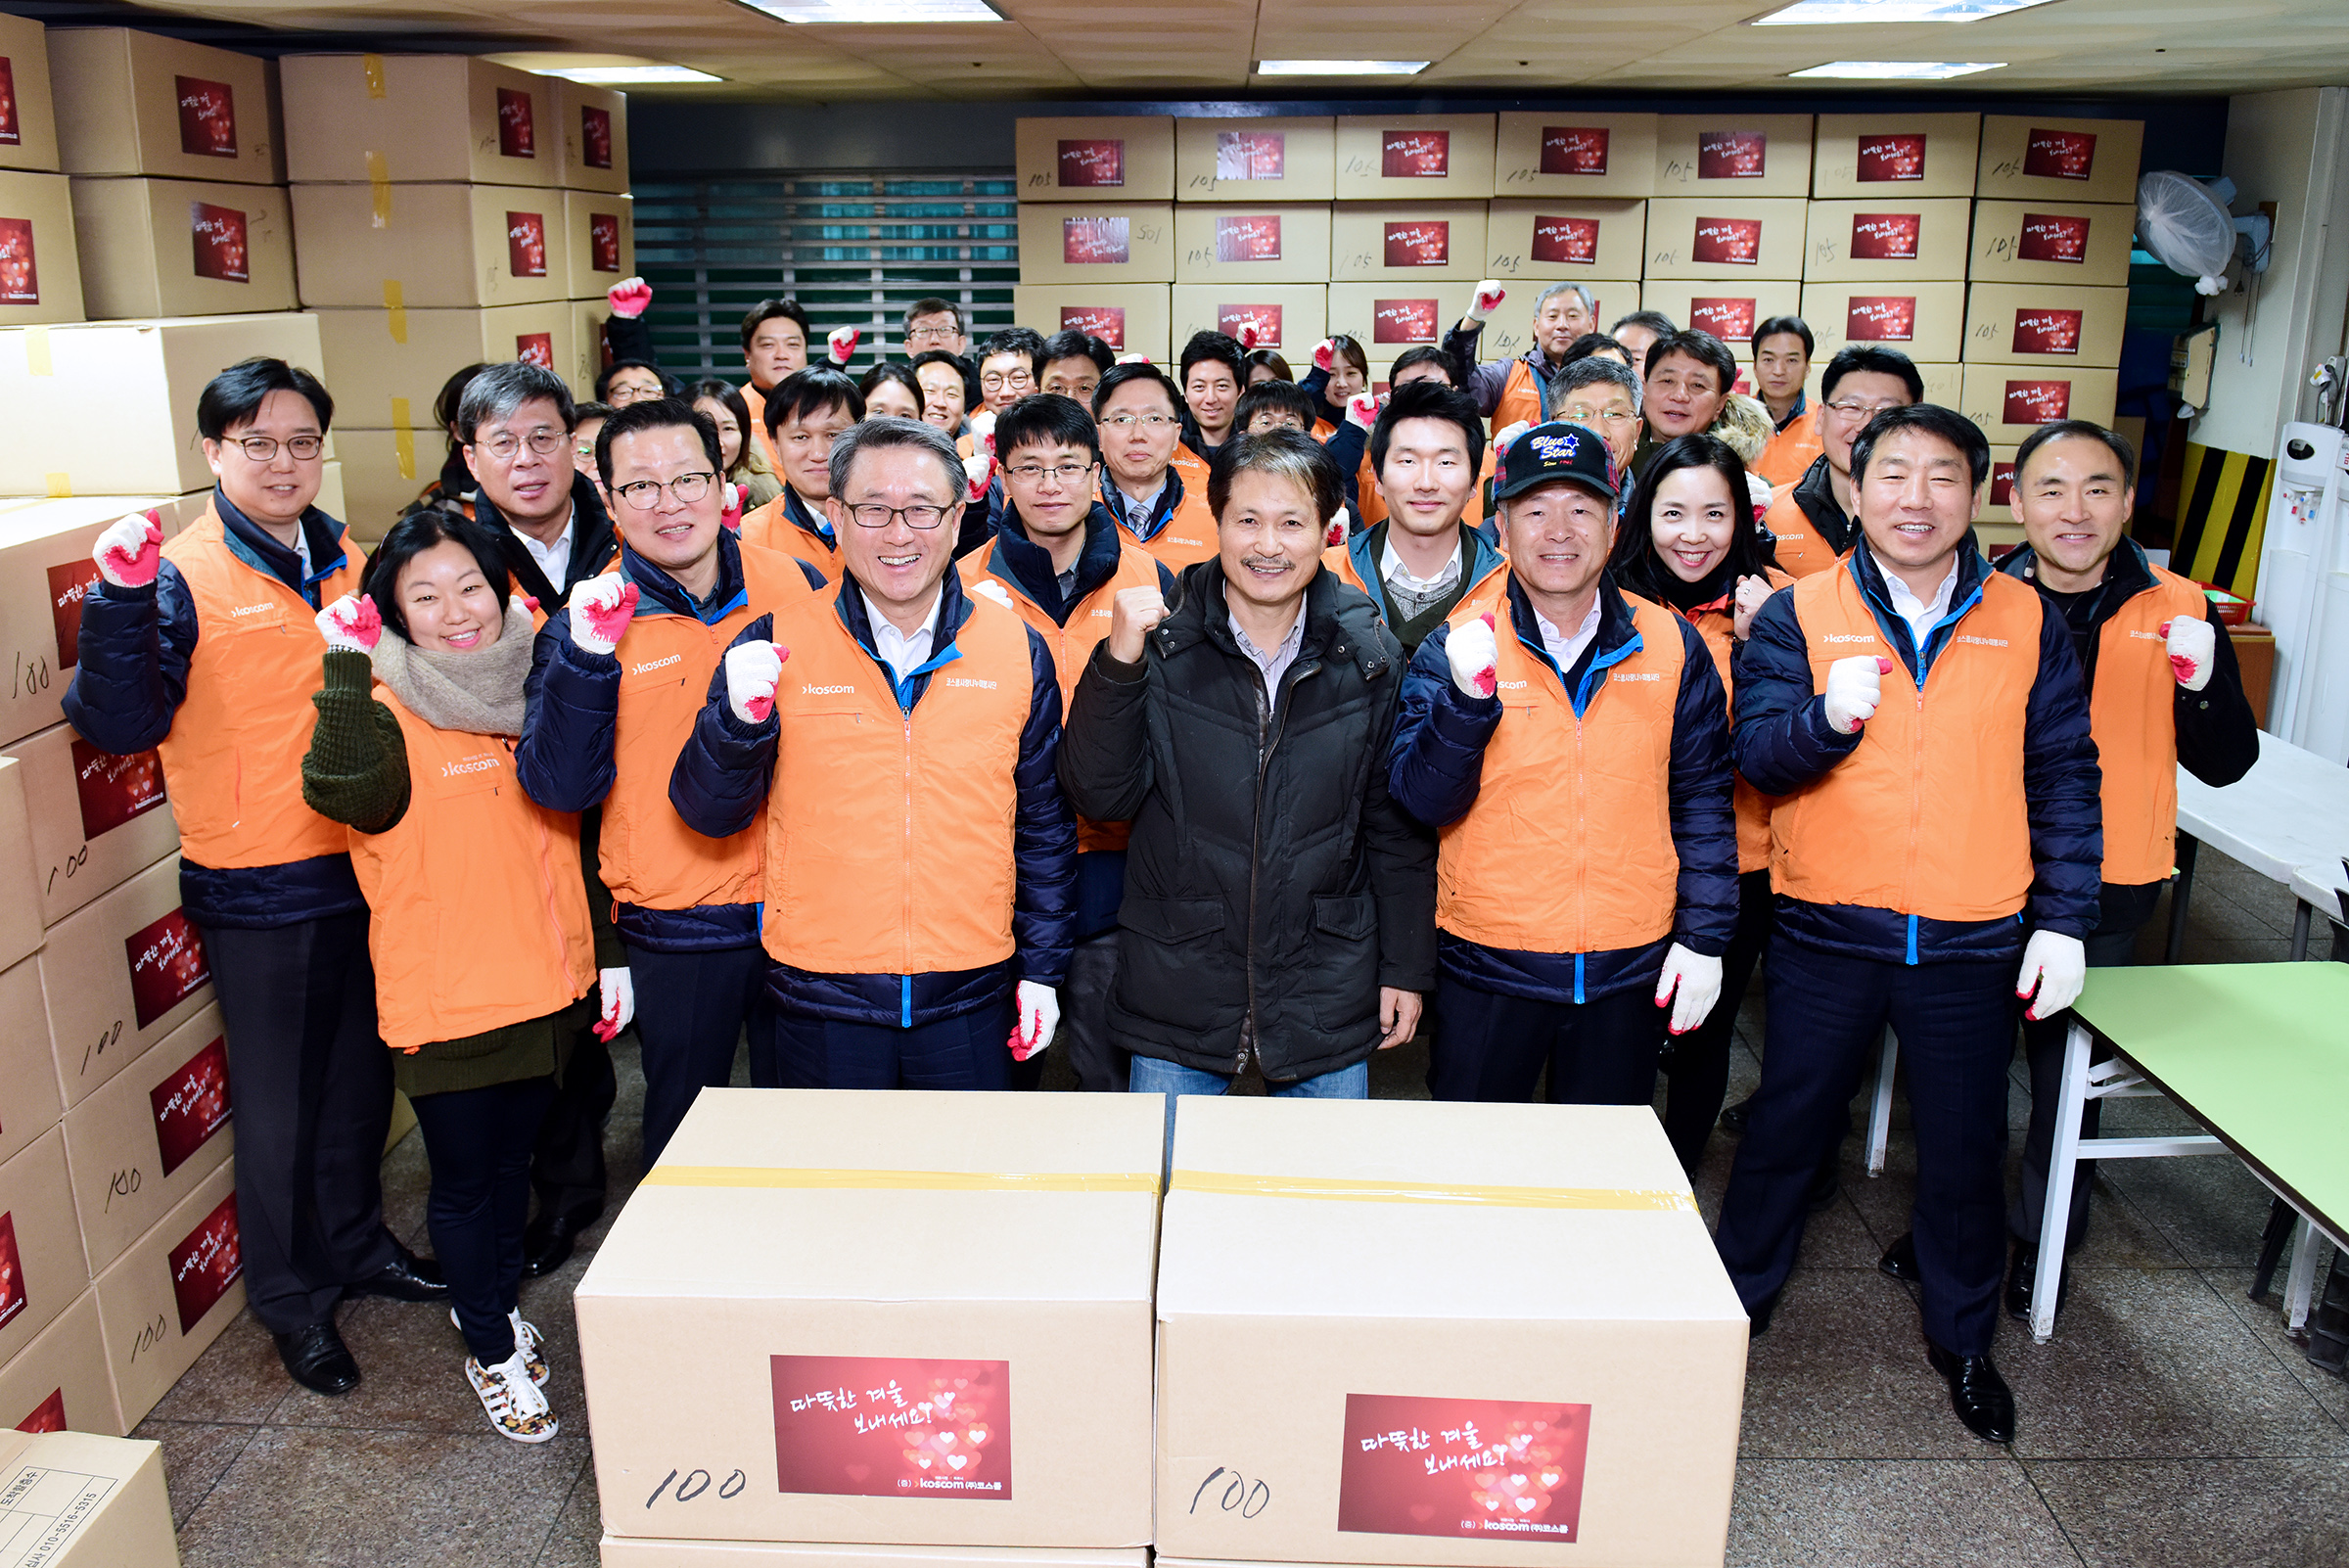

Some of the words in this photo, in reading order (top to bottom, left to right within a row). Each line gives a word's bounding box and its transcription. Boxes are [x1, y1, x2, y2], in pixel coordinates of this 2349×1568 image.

[1531, 436, 1565, 450] Blue
[1541, 446, 1576, 460] Star
[1172, 458, 1200, 468] koscom
[235, 602, 274, 617] koscom
[1829, 634, 1874, 643] koscom
[637, 654, 681, 673] koscom
[13, 652, 50, 699] 100
[808, 683, 854, 695] koscom
[447, 759, 500, 776] koscom
[48, 845, 88, 896] 100
[80, 1021, 122, 1076] 100
[131, 1314, 166, 1363] 100
[790, 1388, 856, 1411] 따뜻한
[866, 1381, 907, 1407] 겨울
[854, 1409, 932, 1434] 보내세요!
[1361, 1428, 1429, 1451] 따뜻한
[1441, 1422, 1482, 1449] 겨울
[1425, 1451, 1504, 1474] 보내세요!
[646, 1468, 747, 1509] 100
[920, 1478, 964, 1489] koscom
[1189, 1467, 1270, 1519] 100
[39, 1493, 97, 1551] 010-5516-5315
[1484, 1519, 1529, 1531] koscom
